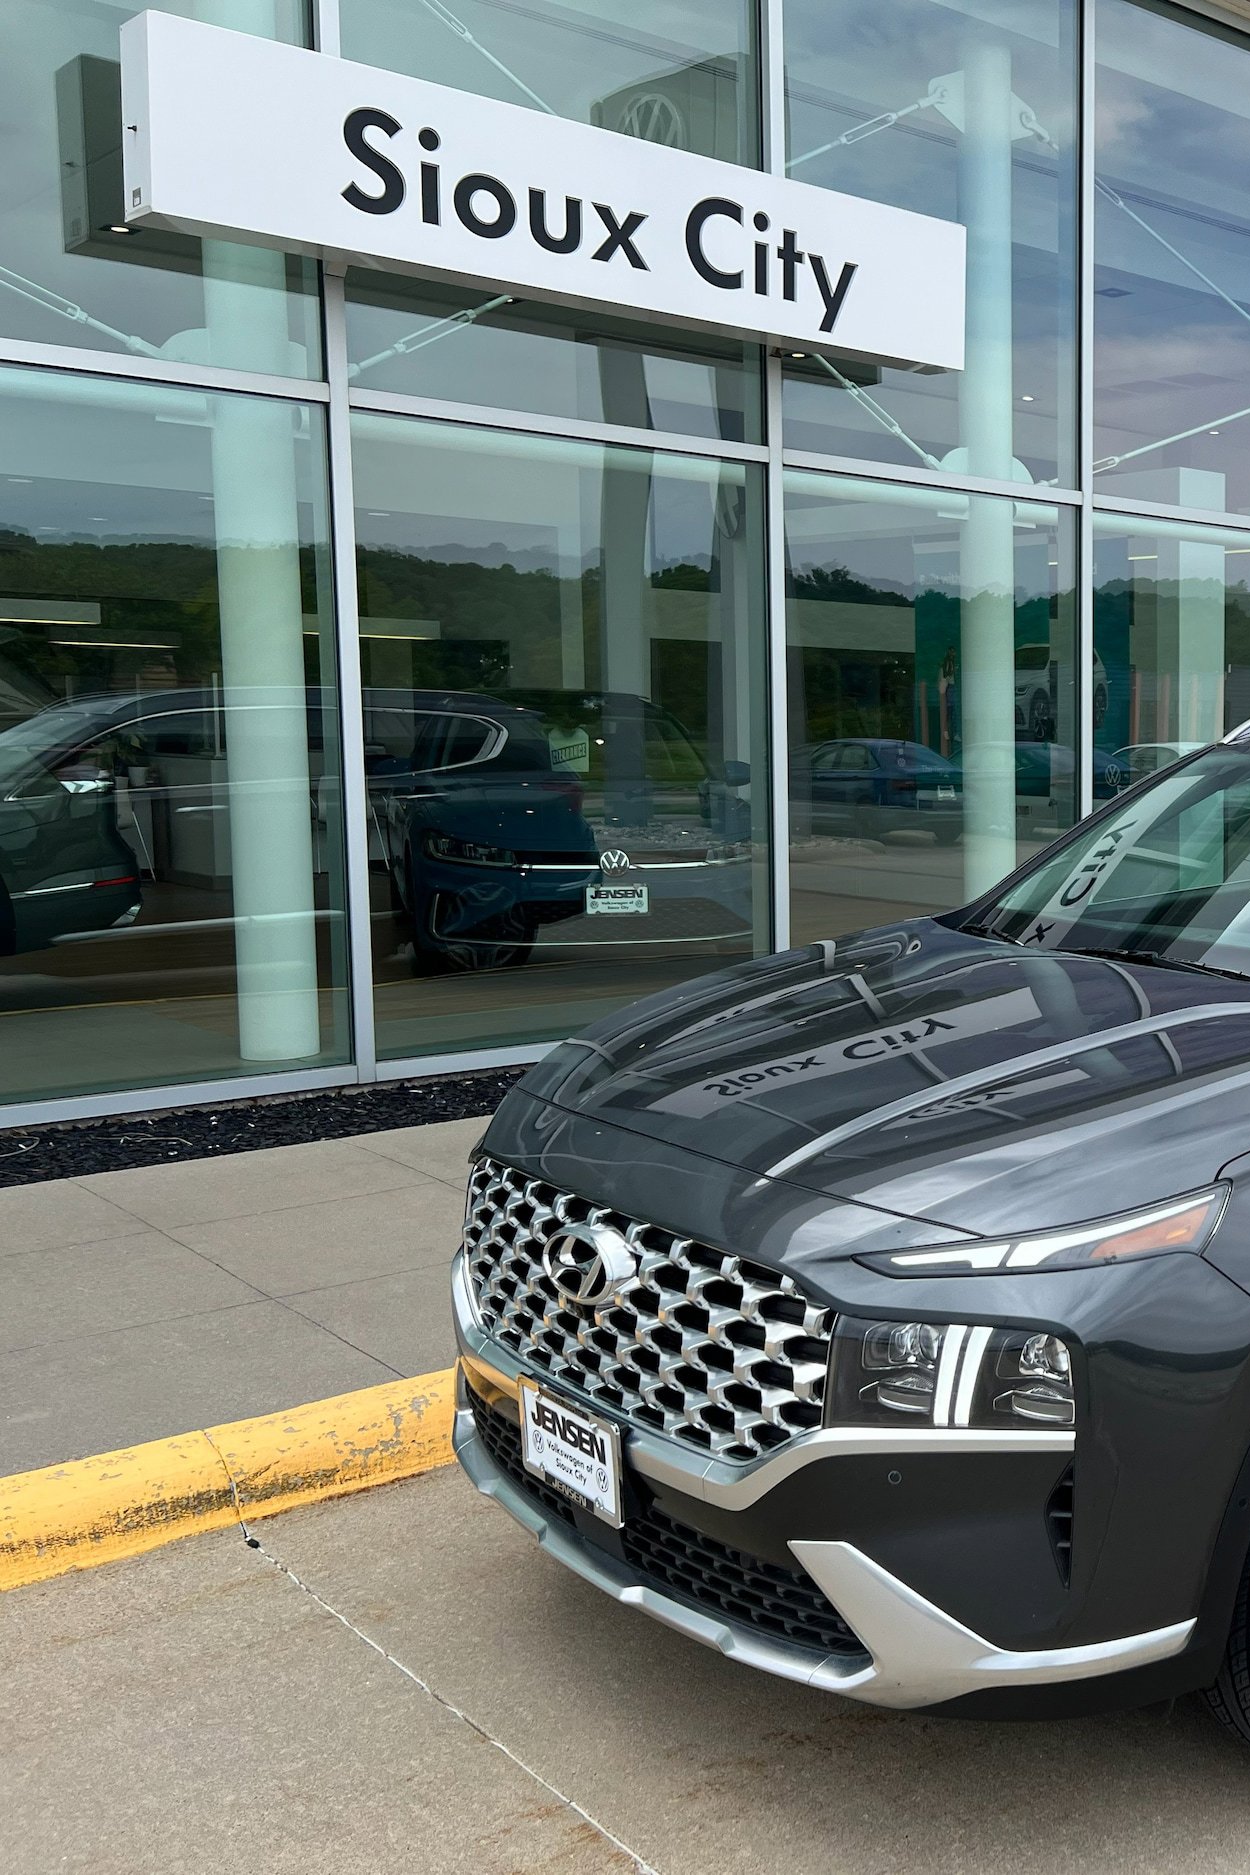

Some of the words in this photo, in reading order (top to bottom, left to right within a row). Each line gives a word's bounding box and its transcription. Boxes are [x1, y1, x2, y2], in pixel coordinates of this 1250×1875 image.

[340, 108, 649, 272] Sioux
[685, 198, 858, 333] City
[590, 889, 643, 900] JENSEN
[531, 1400, 607, 1466] JENSEN
[546, 1439, 585, 1470] Volkswagen
[586, 1464, 593, 1474] of
[555, 1457, 574, 1476] Sioux
[574, 1469, 587, 1486] City
[551, 1478, 588, 1507] JENSEN
